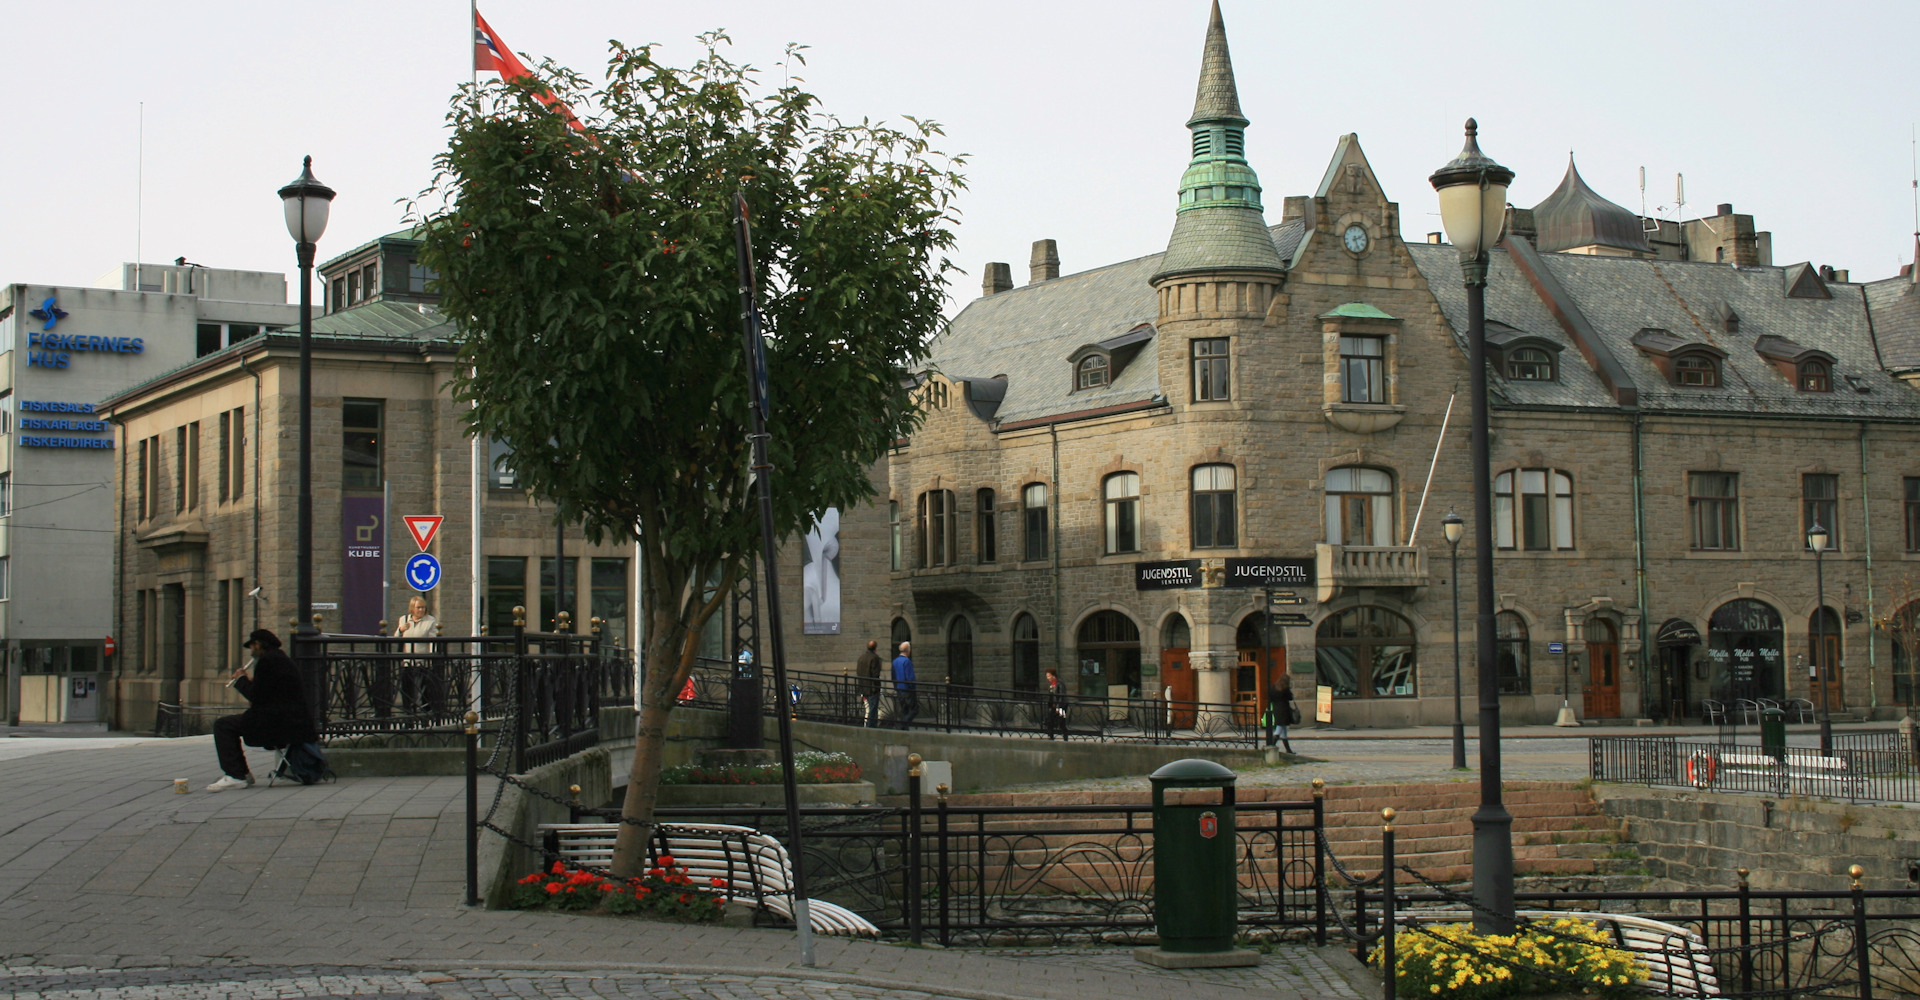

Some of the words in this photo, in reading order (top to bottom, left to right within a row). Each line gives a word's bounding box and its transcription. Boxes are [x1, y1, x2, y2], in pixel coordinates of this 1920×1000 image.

[27, 332, 144, 354] FISKERNES
[27, 351, 71, 369] HUS
[20, 418, 109, 431] FISKARLAGET
[348, 550, 380, 558] KUBE
[1142, 567, 1193, 580] JUGENDSTIL
[1235, 565, 1307, 577] JUGENDSTIL
[1161, 578, 1193, 586] SENTERET
